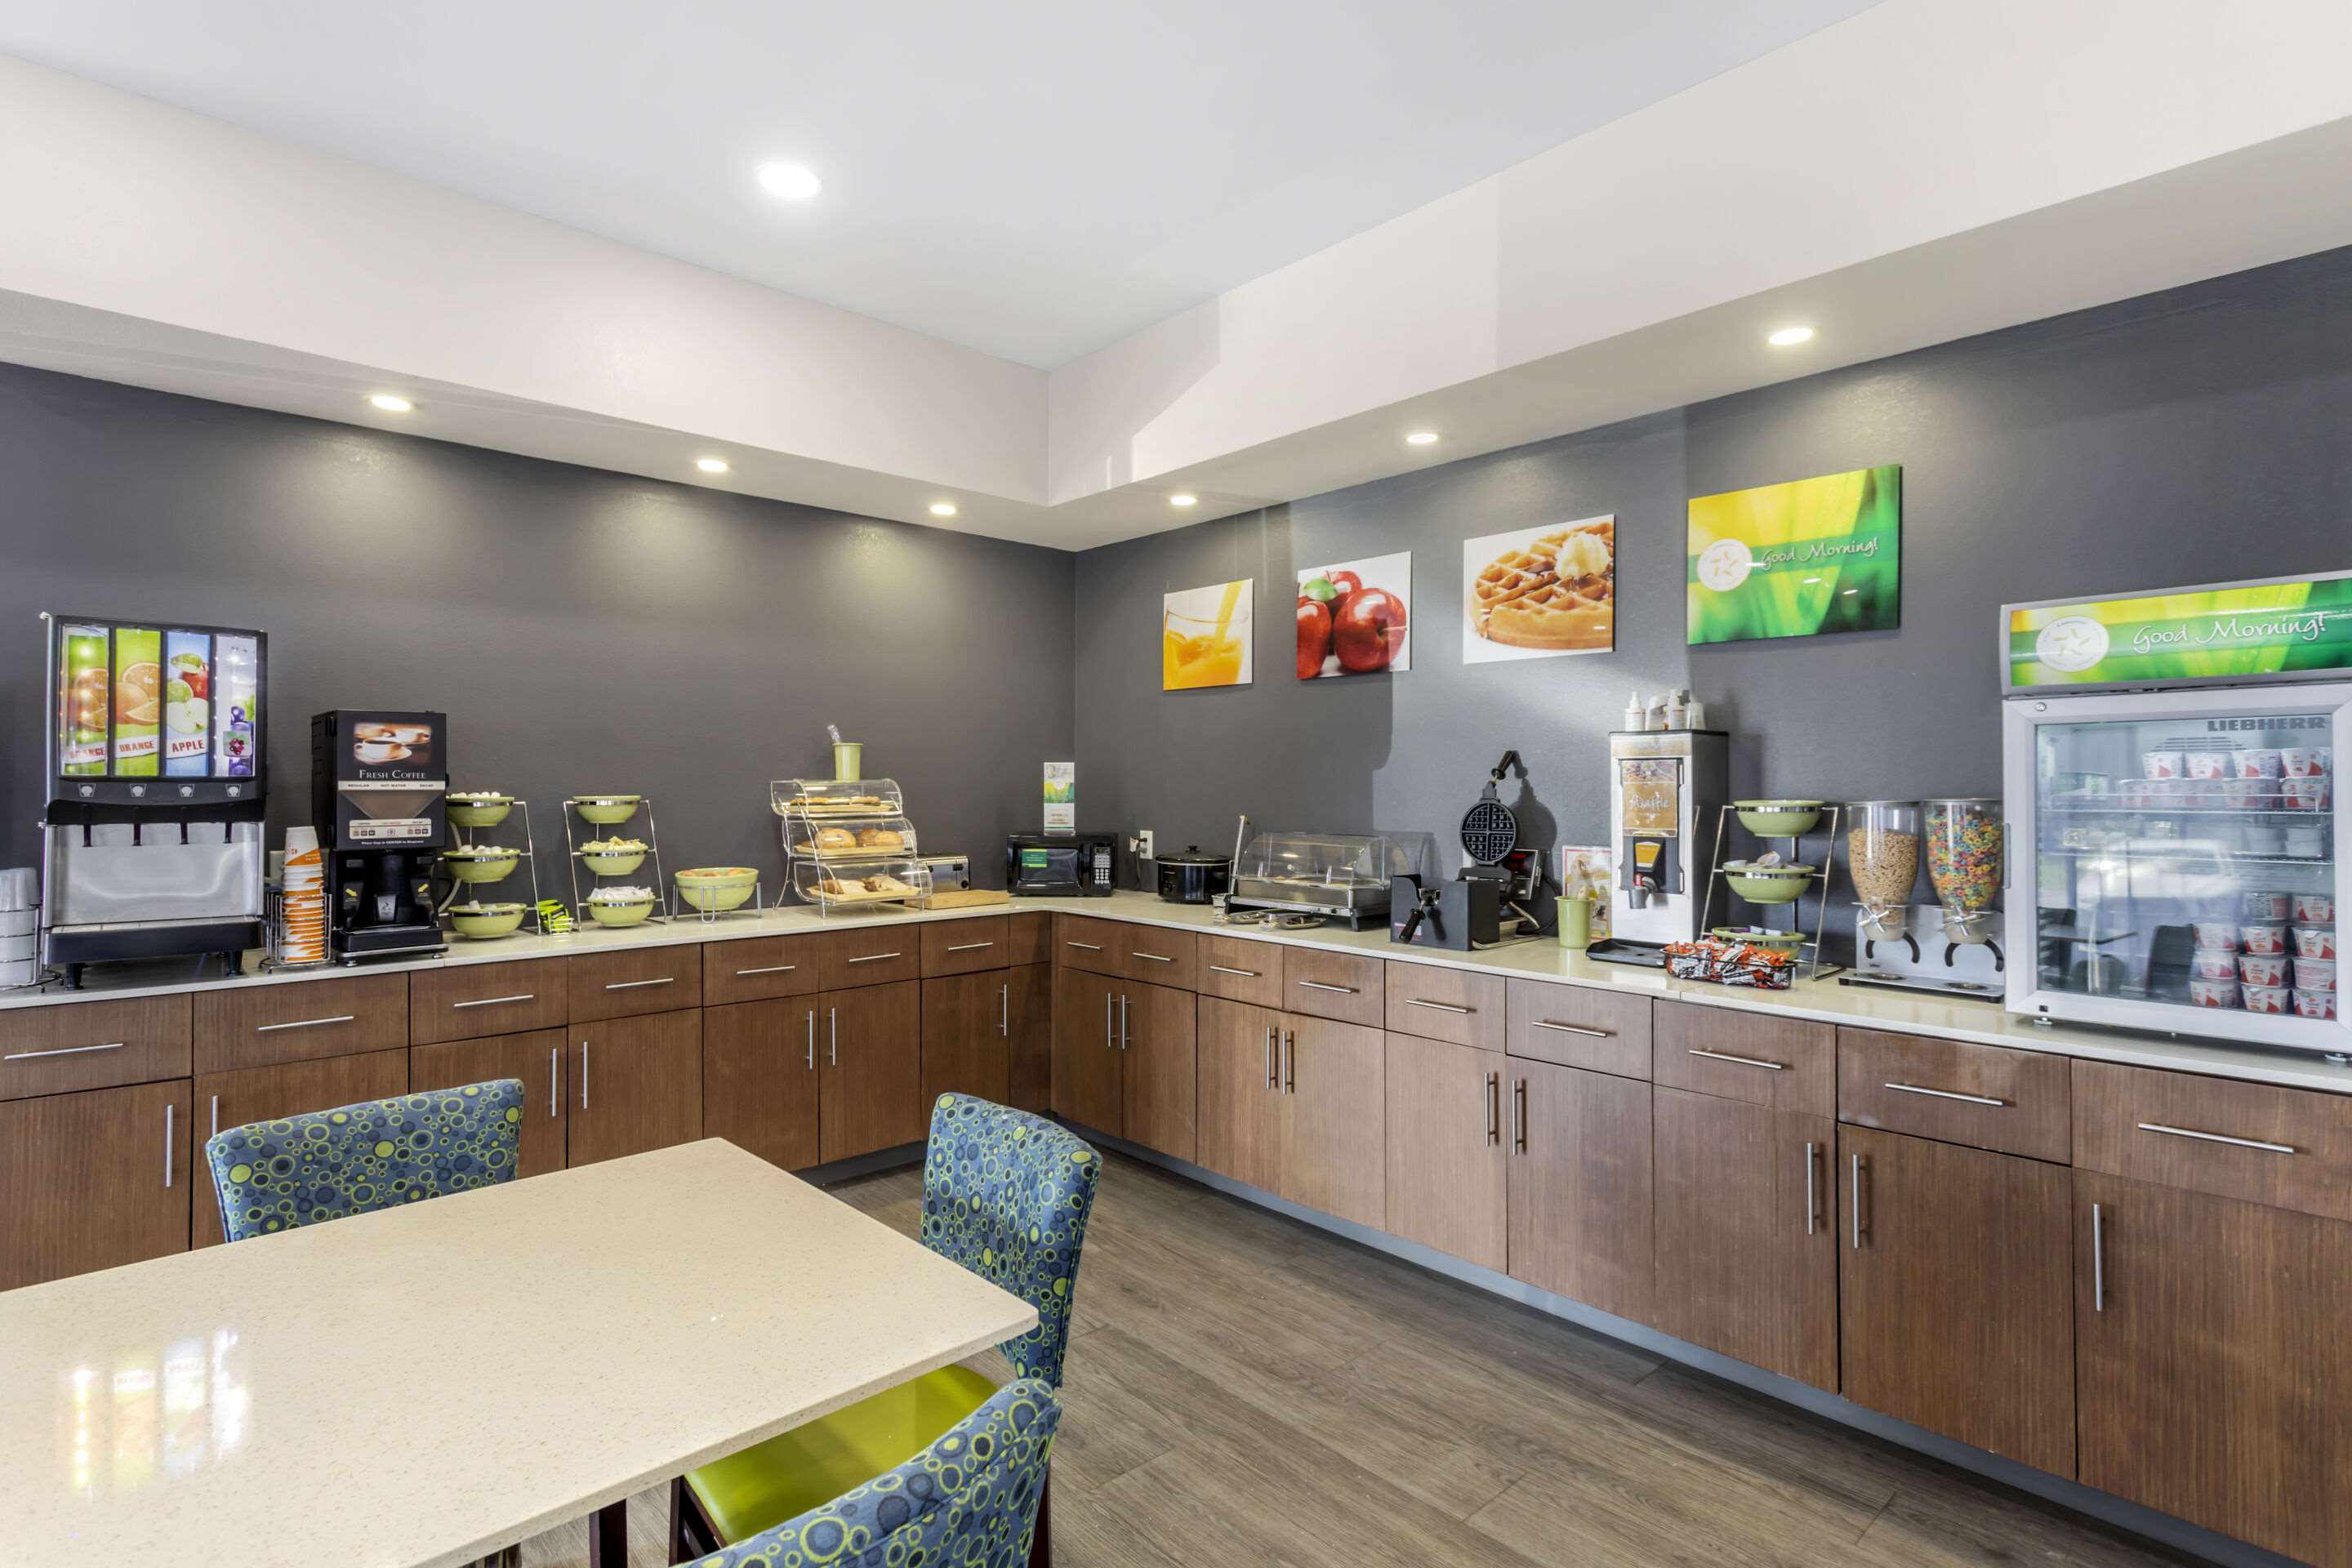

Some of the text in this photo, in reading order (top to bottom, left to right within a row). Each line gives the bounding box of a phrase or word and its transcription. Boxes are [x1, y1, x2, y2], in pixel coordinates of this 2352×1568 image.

[1761, 537, 1878, 572] Good Morning!
[2132, 612, 2327, 654] Good Morning!
[2207, 716, 2326, 732] LIEBHERR
[119, 740, 154, 752] ORANGE
[172, 739, 205, 752] APPLE
[69, 746, 105, 759] NGE
[359, 769, 425, 779] FRESH COFFEE
